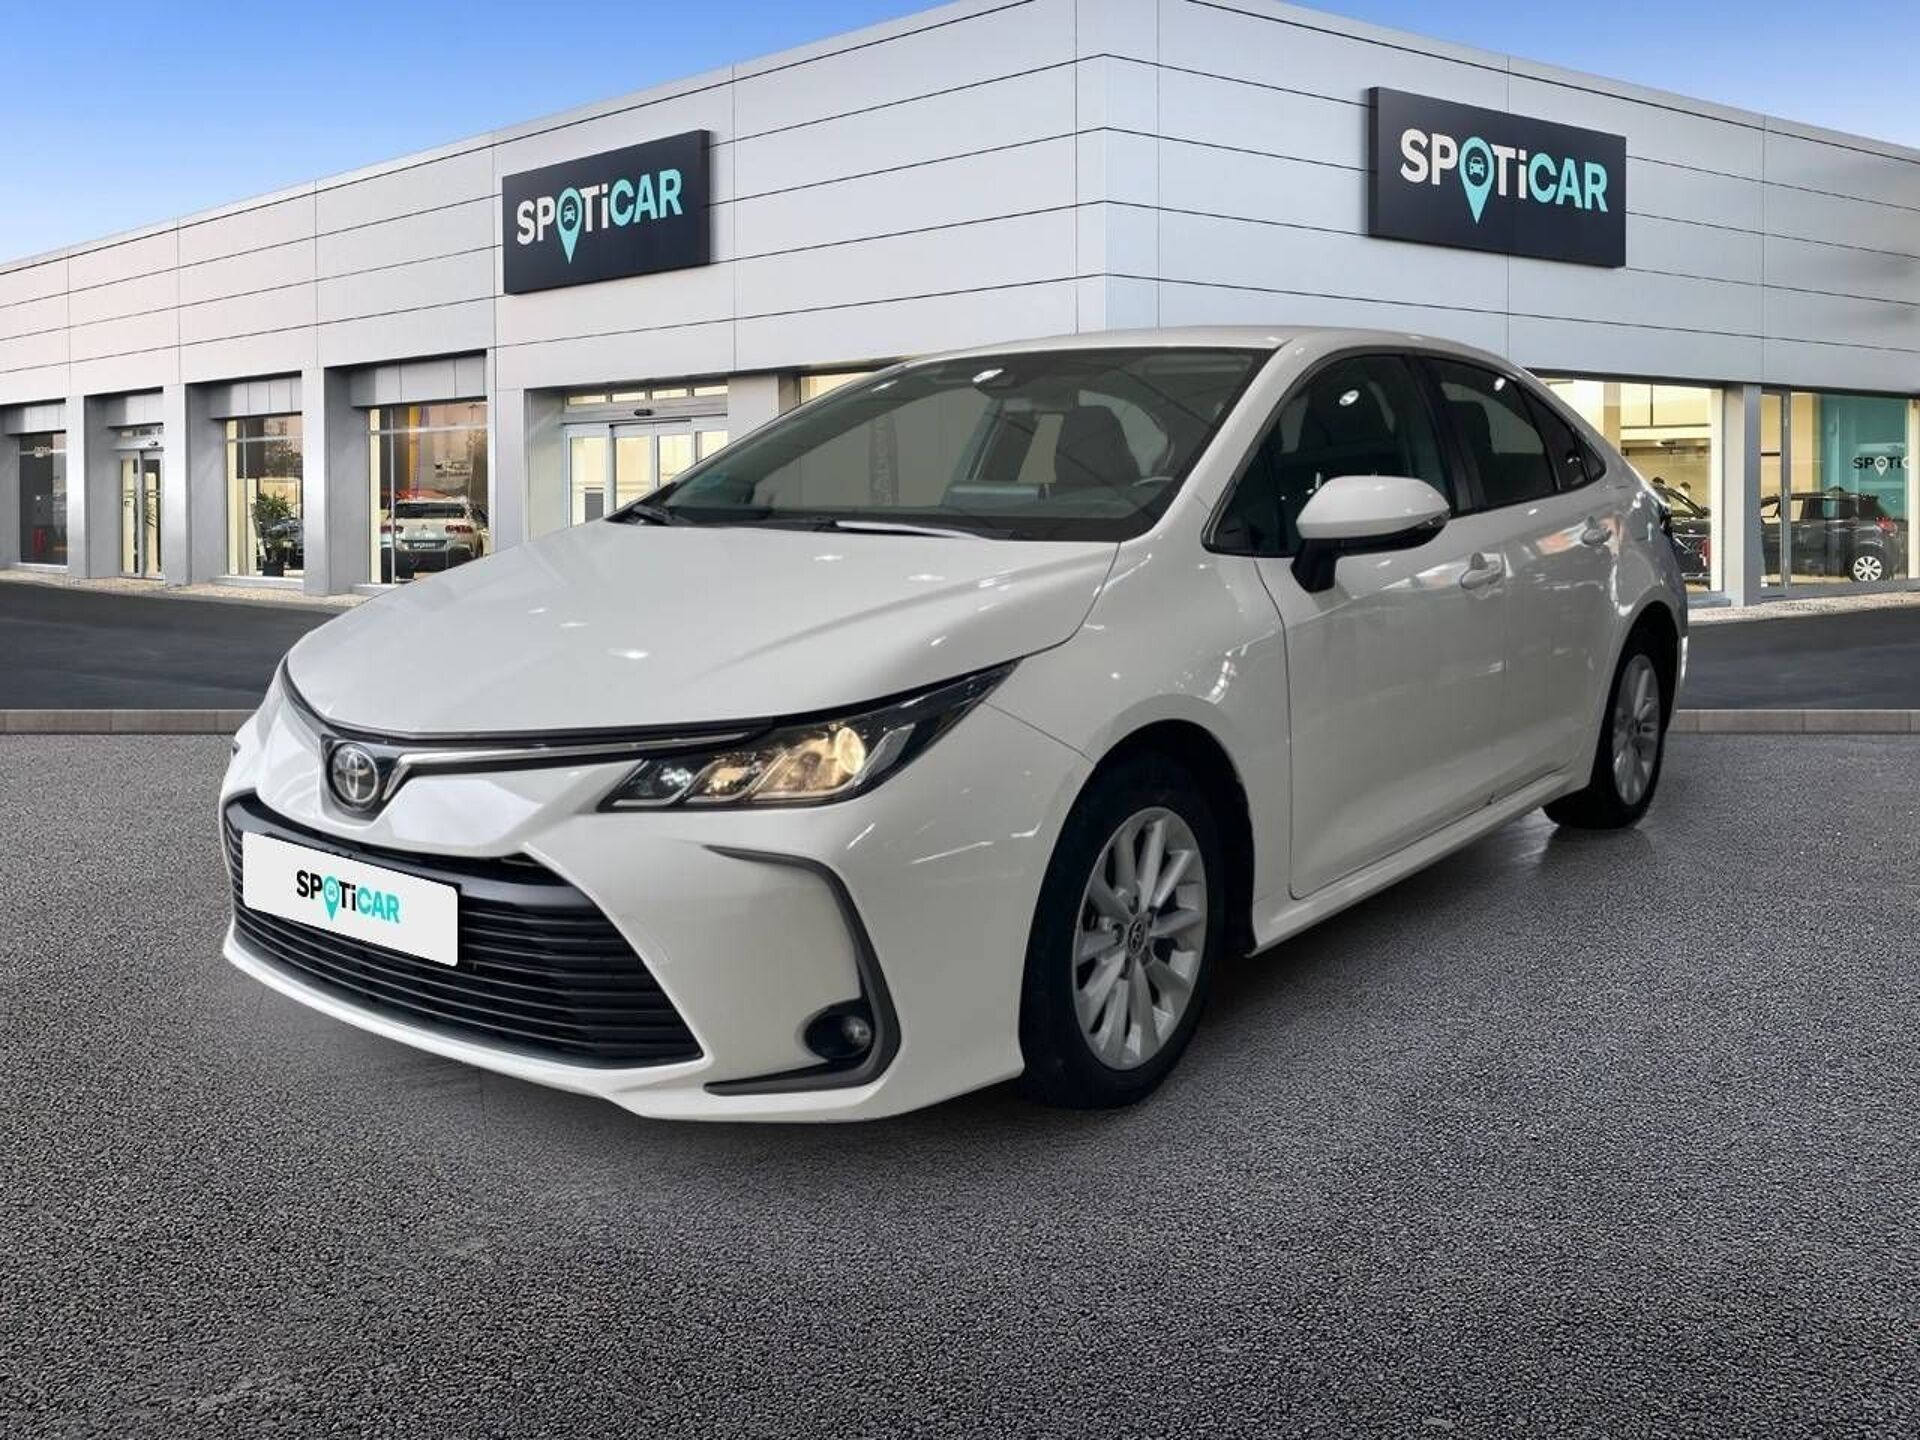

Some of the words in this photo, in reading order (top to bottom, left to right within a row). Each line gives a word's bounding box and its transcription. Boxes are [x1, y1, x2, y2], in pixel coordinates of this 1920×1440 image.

[517, 168, 683, 264] SPOTiCAR
[1400, 128, 1608, 224] SPOTiCAR
[296, 870, 400, 923] SPOTiCAR
